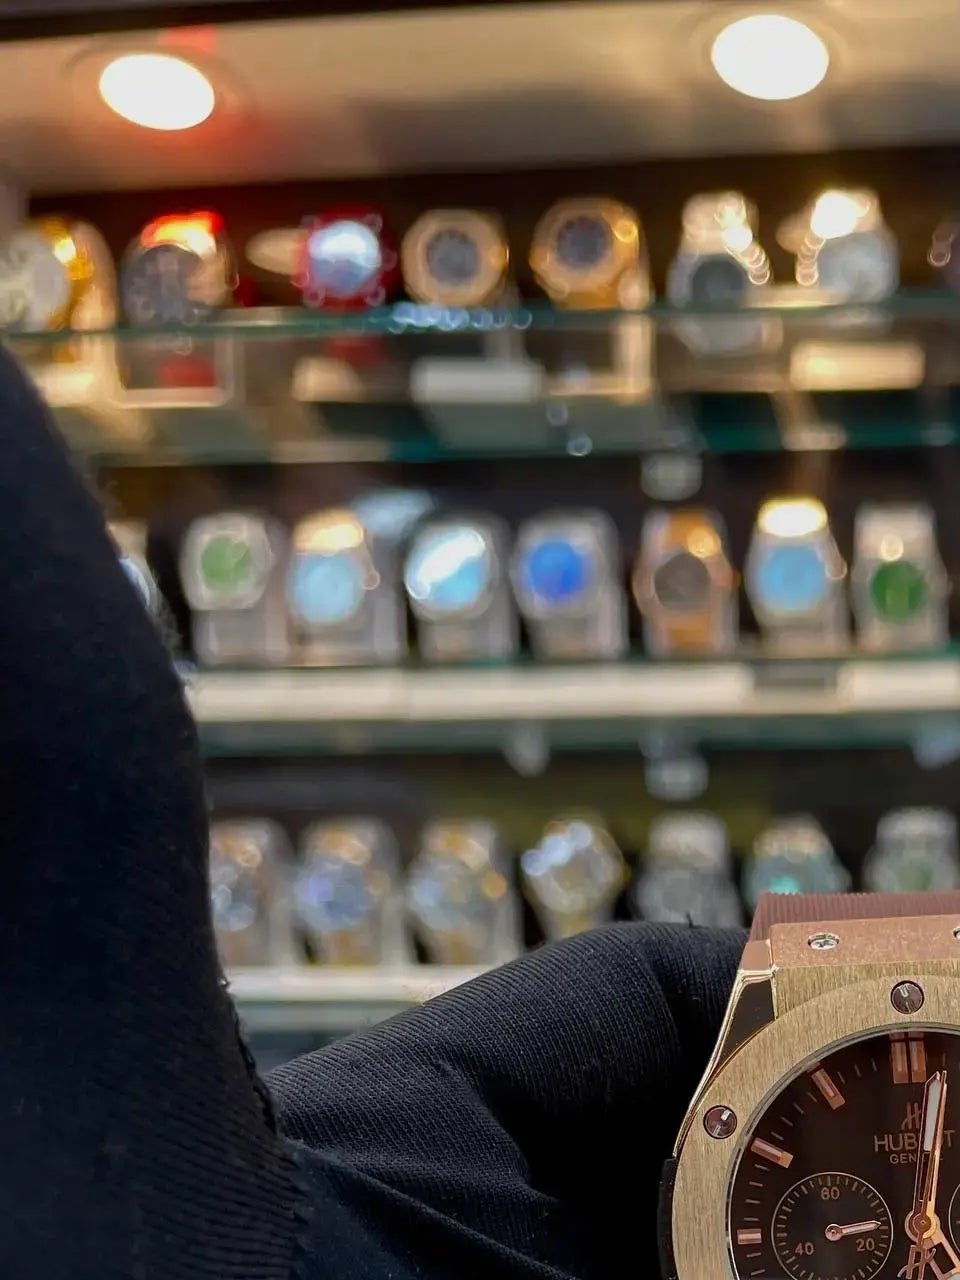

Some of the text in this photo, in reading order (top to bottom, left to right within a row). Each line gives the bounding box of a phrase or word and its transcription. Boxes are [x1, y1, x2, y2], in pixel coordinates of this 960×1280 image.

[873, 1129, 956, 1152] HUBT
[889, 1152, 944, 1165] GEN
[821, 1186, 840, 1200] 60
[795, 1241, 814, 1256] 40
[856, 1238, 875, 1252] 20
